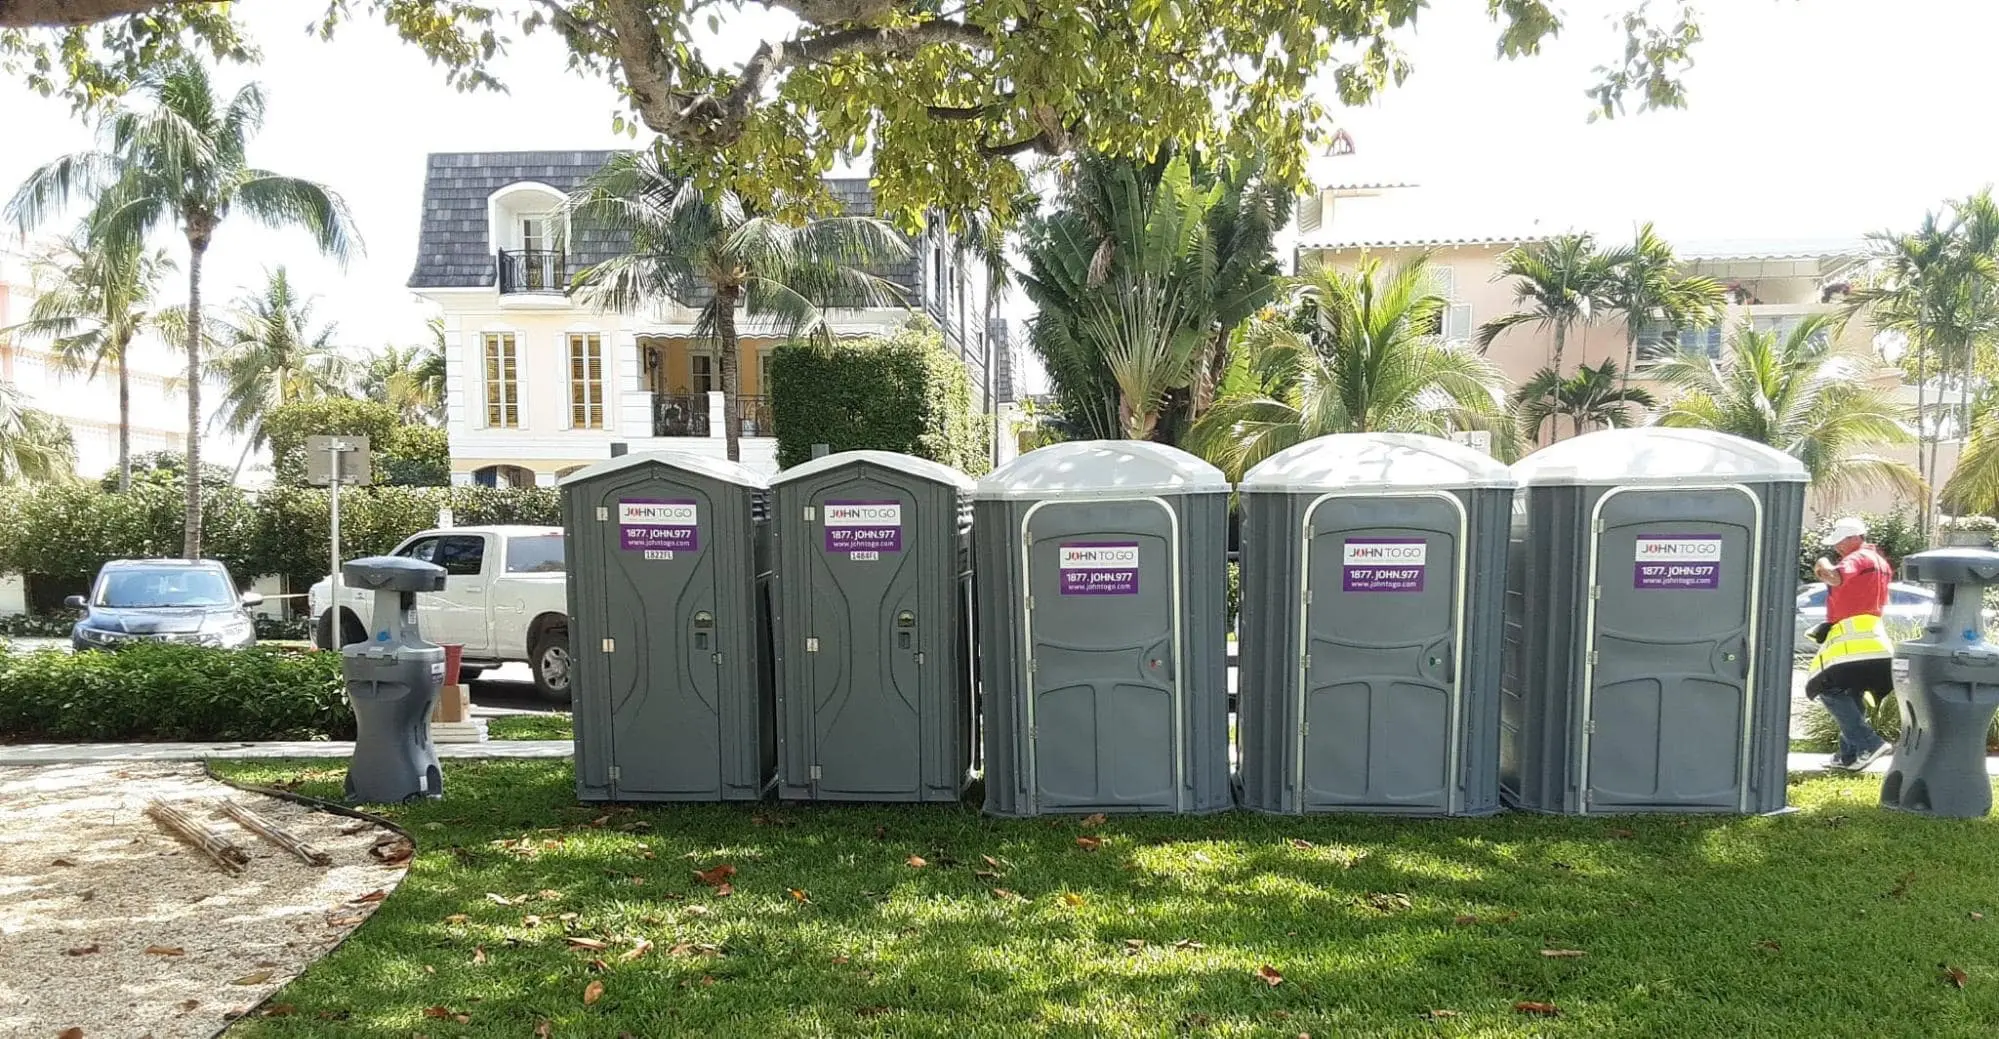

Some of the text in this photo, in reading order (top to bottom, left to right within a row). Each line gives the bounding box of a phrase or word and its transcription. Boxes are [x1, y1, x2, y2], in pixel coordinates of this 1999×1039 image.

[624, 508, 692, 518] JOHN TO GO
[830, 509, 896, 518] JOHN TO GO
[1350, 548, 1421, 558] JOHN TO GO
[1641, 544, 1716, 554] JOHN TO GO
[1065, 552, 1134, 560] JOHN TO GO
